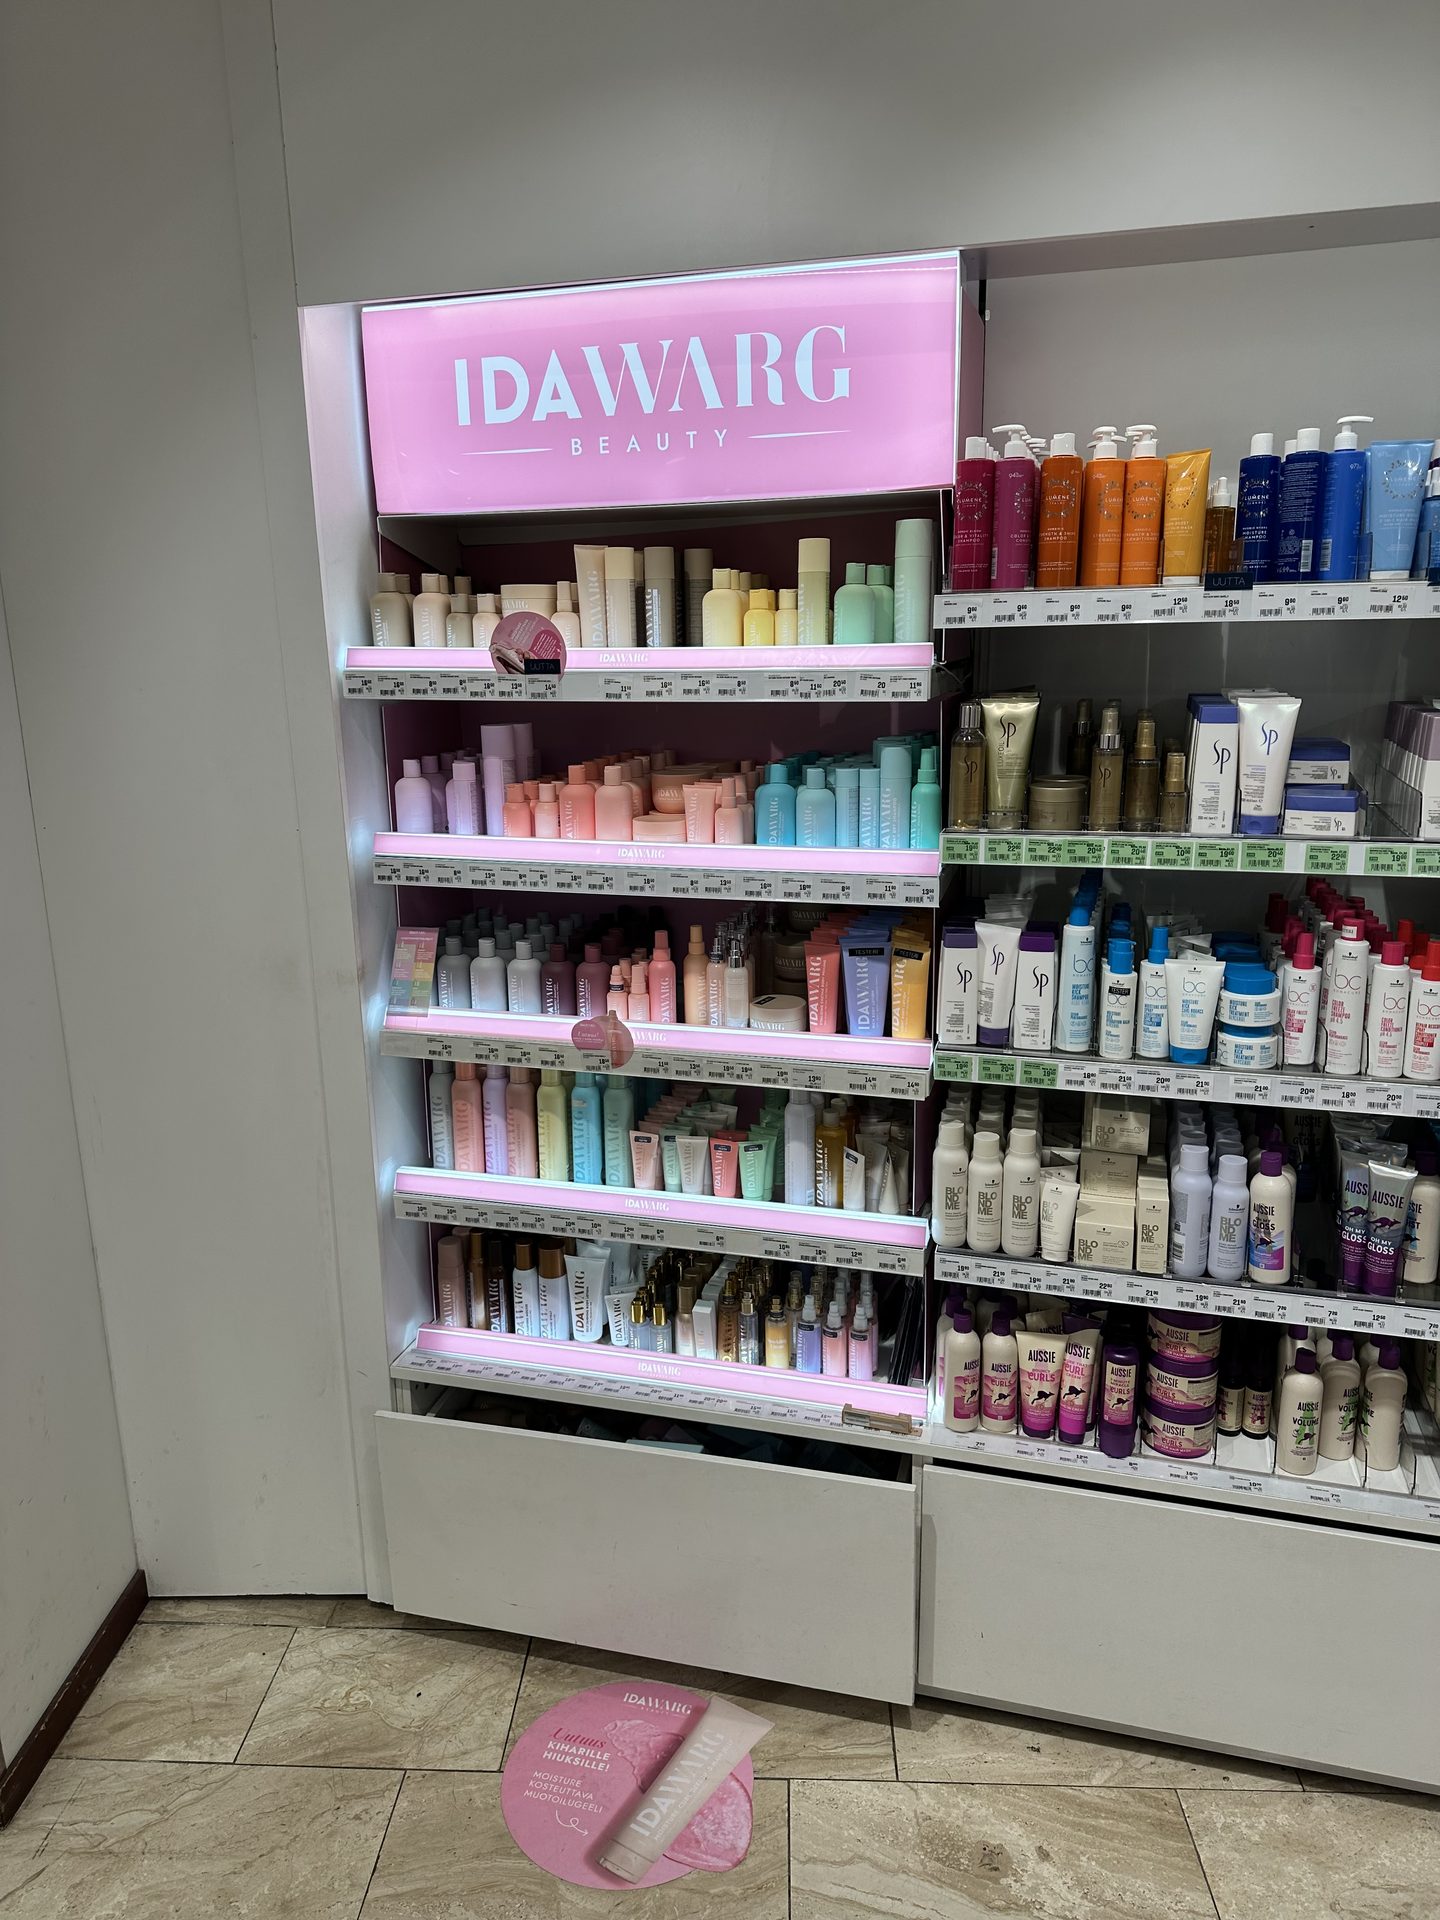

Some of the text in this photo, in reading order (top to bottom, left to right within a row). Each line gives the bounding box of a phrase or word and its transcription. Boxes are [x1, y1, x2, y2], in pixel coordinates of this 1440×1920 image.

[455, 325, 851, 426] IDAWARG
[571, 429, 729, 456] BEAUTY
[1212, 576, 1246, 587] UUTTA
[645, 588, 653, 647] AWARG
[600, 653, 648, 663] IDAWARG
[617, 848, 665, 859] IDAWARG
[810, 957, 822, 1026] IDAWARG
[856, 957, 870, 1030] IDAWARG
[892, 959, 907, 1032] IDAWARG
[945, 1186, 964, 1195] BLO
[1345, 1179, 1368, 1196] AUSS
[945, 1194, 960, 1202] ND
[978, 1192, 997, 1200] BLO
[1013, 1195, 1032, 1204] BLO
[1372, 1190, 1405, 1209] AUSSIE
[625, 1197, 670, 1211] IDAWARG
[945, 1202, 960, 1210] ME
[978, 1200, 992, 1208] ND
[1012, 1203, 1027, 1211] ND
[1253, 1202, 1275, 1216] AUSSIE
[977, 1207, 993, 1215] ME
[1012, 1211, 1028, 1219] ME
[1220, 1216, 1242, 1227] BLO
[1252, 1219, 1276, 1231] GLOSS
[1141, 1224, 1159, 1233] BLO
[1141, 1230, 1154, 1238] ND
[1219, 1225, 1236, 1235] ND
[1141, 1235, 1155, 1244] ME
[1218, 1233, 1237, 1243] ME
[1381, 1239, 1392, 1247] MY
[1078, 1239, 1098, 1249] BLO
[1367, 1241, 1395, 1256] GLOSS
[1078, 1247, 1093, 1255] ND
[1077, 1253, 1093, 1262] ME
[575, 1270, 586, 1333] IDAWARG
[1166, 1328, 1190, 1341] AUSSIE
[1165, 1343, 1187, 1353] CURLS
[1028, 1349, 1056, 1363] AUSSIE
[637, 1361, 682, 1376] IDAWARG
[991, 1362, 1012, 1373] AUSSIE
[1065, 1363, 1085, 1377] CURL
[1111, 1366, 1132, 1377] AUSSIE
[990, 1378, 1011, 1387] CURLS
[1027, 1372, 1056, 1382] CURLS
[1157, 1373, 1179, 1388] AUSSIE
[1110, 1386, 1130, 1395] CURLS
[1156, 1388, 1176, 1399] CURLS
[1343, 1387, 1359, 1398] AUSS
[1297, 1401, 1319, 1412] AUSSIE
[1292, 1417, 1319, 1427] VOLUME
[1162, 1423, 1185, 1436] AUSSIE
[1161, 1437, 1183, 1447] CURLS
[623, 1692, 693, 1715] IDAWARG
[547, 1741, 611, 1761] KIHARILLE
[543, 1751, 610, 1772] HIUKSILLE!
[533, 1770, 583, 1788] MOISTURE
[629, 1728, 725, 1837] IDAWARG
[528, 1780, 594, 1800] KOSTEUTTAVA
[523, 1789, 603, 1814] MUOTOILUGEELI
